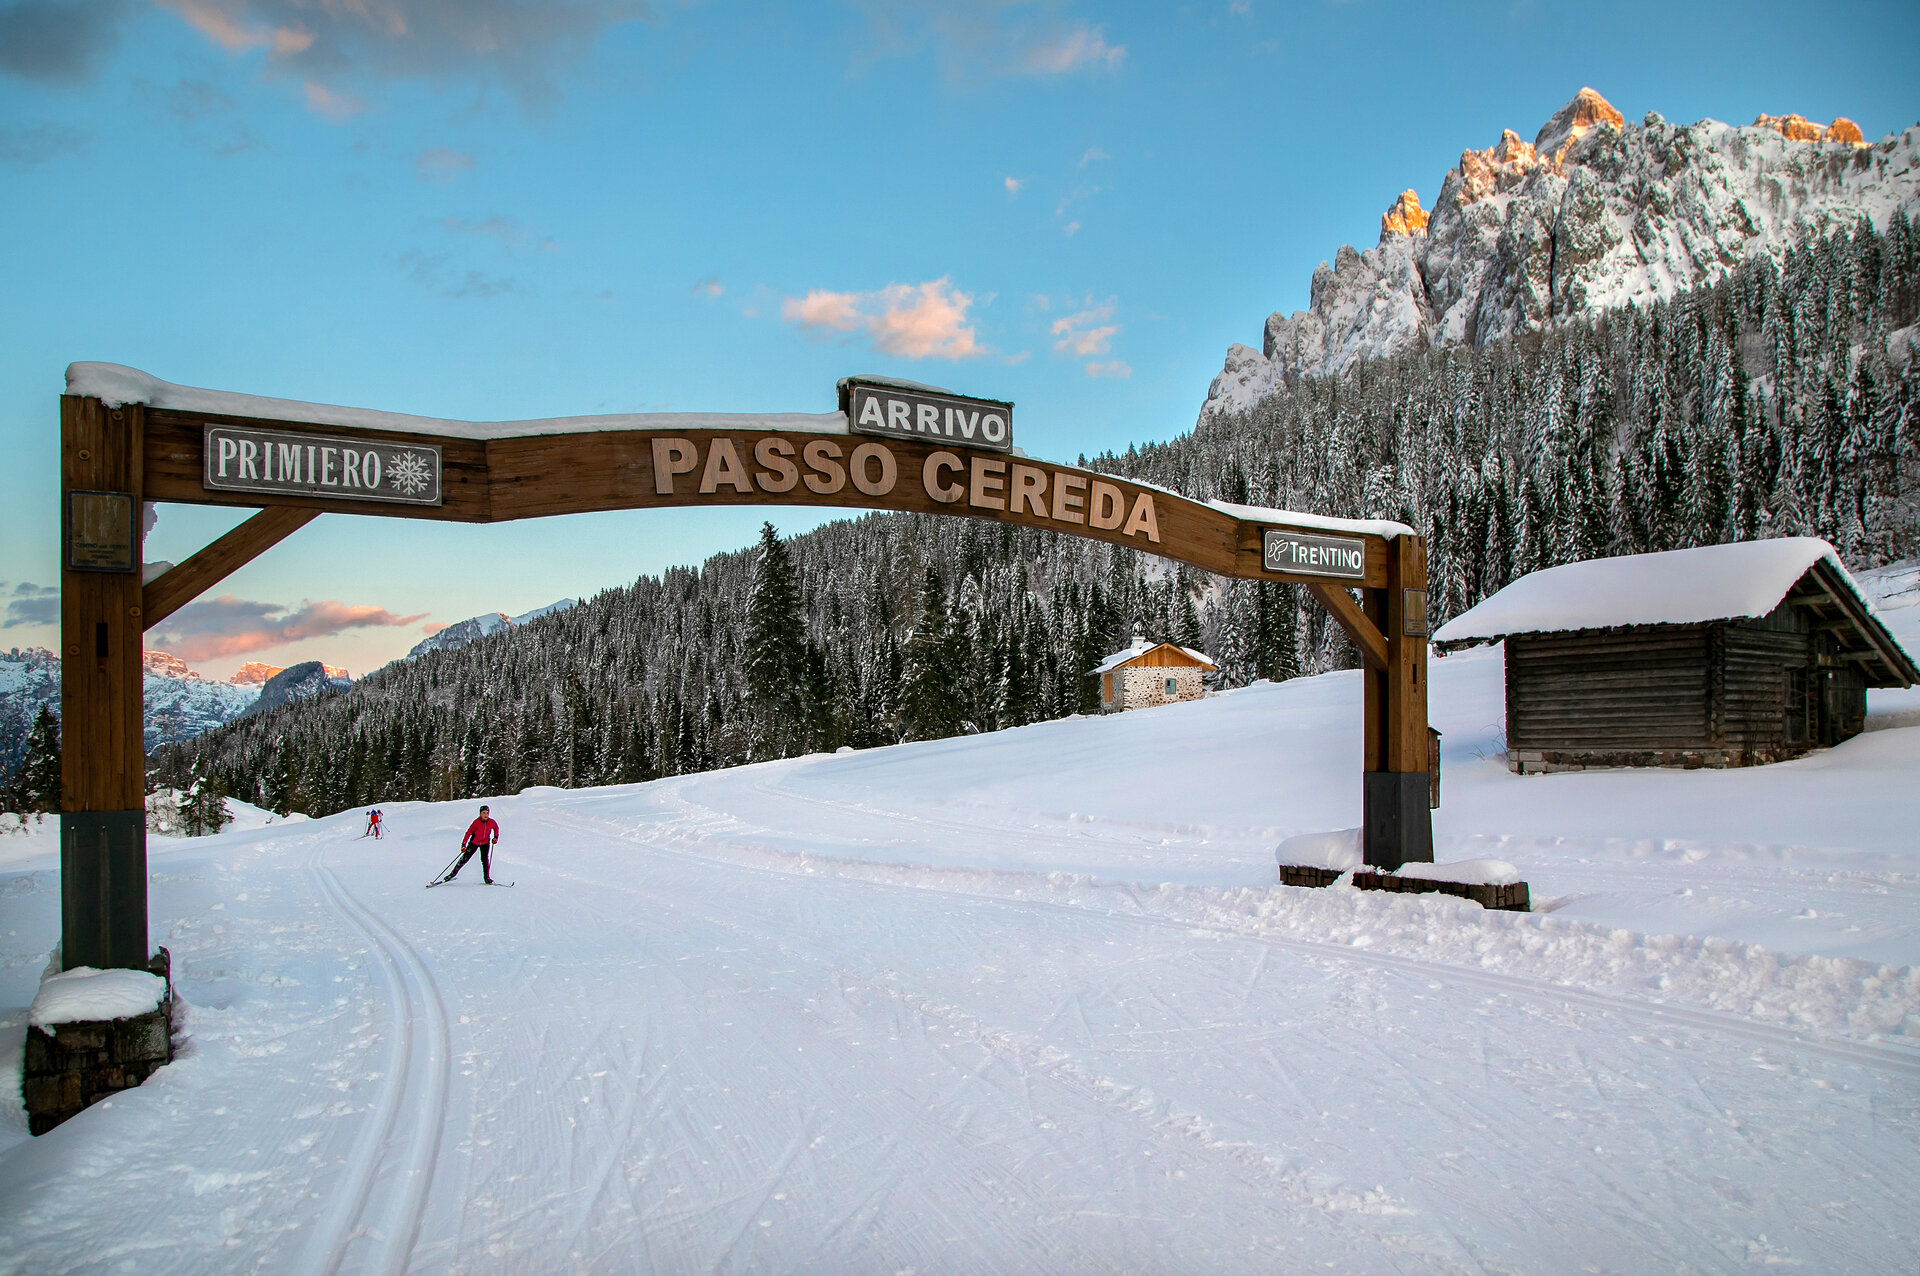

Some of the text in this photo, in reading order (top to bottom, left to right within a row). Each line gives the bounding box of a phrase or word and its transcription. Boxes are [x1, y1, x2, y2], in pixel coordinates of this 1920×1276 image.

[858, 396, 1006, 443] ARRIVO
[217, 437, 382, 489] PRIMIERO
[651, 437, 1161, 543] PASSO CEREDA
